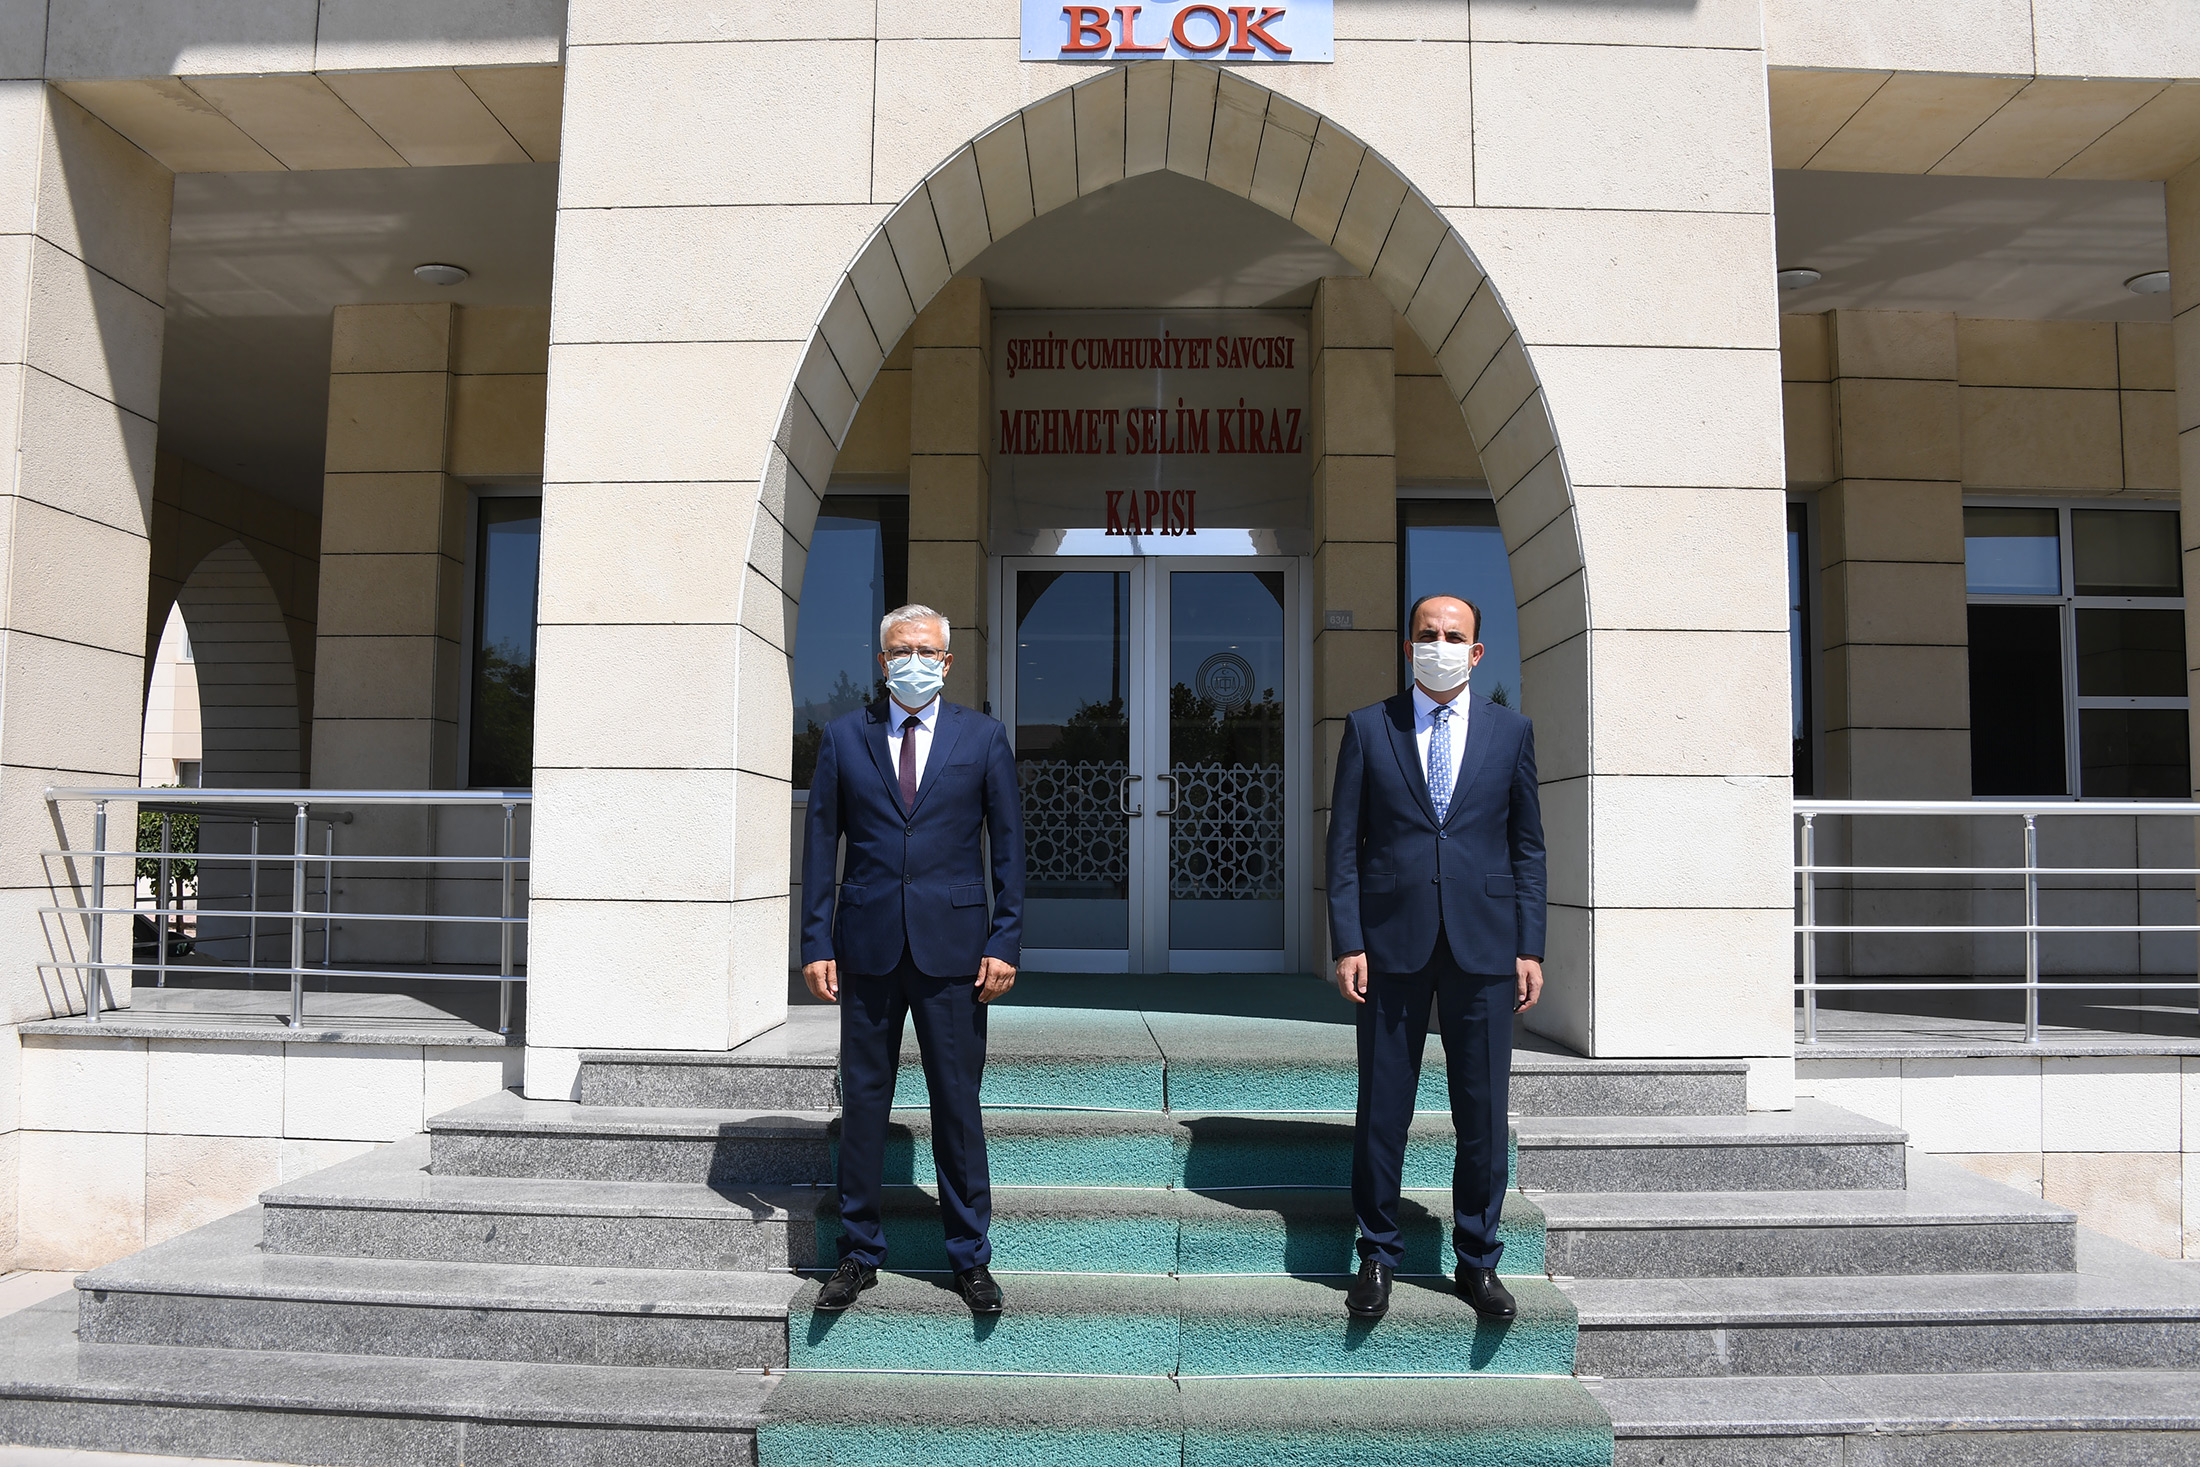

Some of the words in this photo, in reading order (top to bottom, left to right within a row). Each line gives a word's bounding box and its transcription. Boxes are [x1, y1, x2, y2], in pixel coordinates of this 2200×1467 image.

[1061, 4, 1292, 53] BLOK
[1007, 331, 1068, 378] ŞEHİT
[1071, 330, 1213, 369] CUMHURİYET
[1216, 336, 1295, 369] SAVCISI
[1000, 409, 1119, 454] MEHMET
[1126, 397, 1210, 455] SELİM
[1216, 397, 1302, 454] KİRAZ
[1105, 489, 1196, 537] KAPISI
